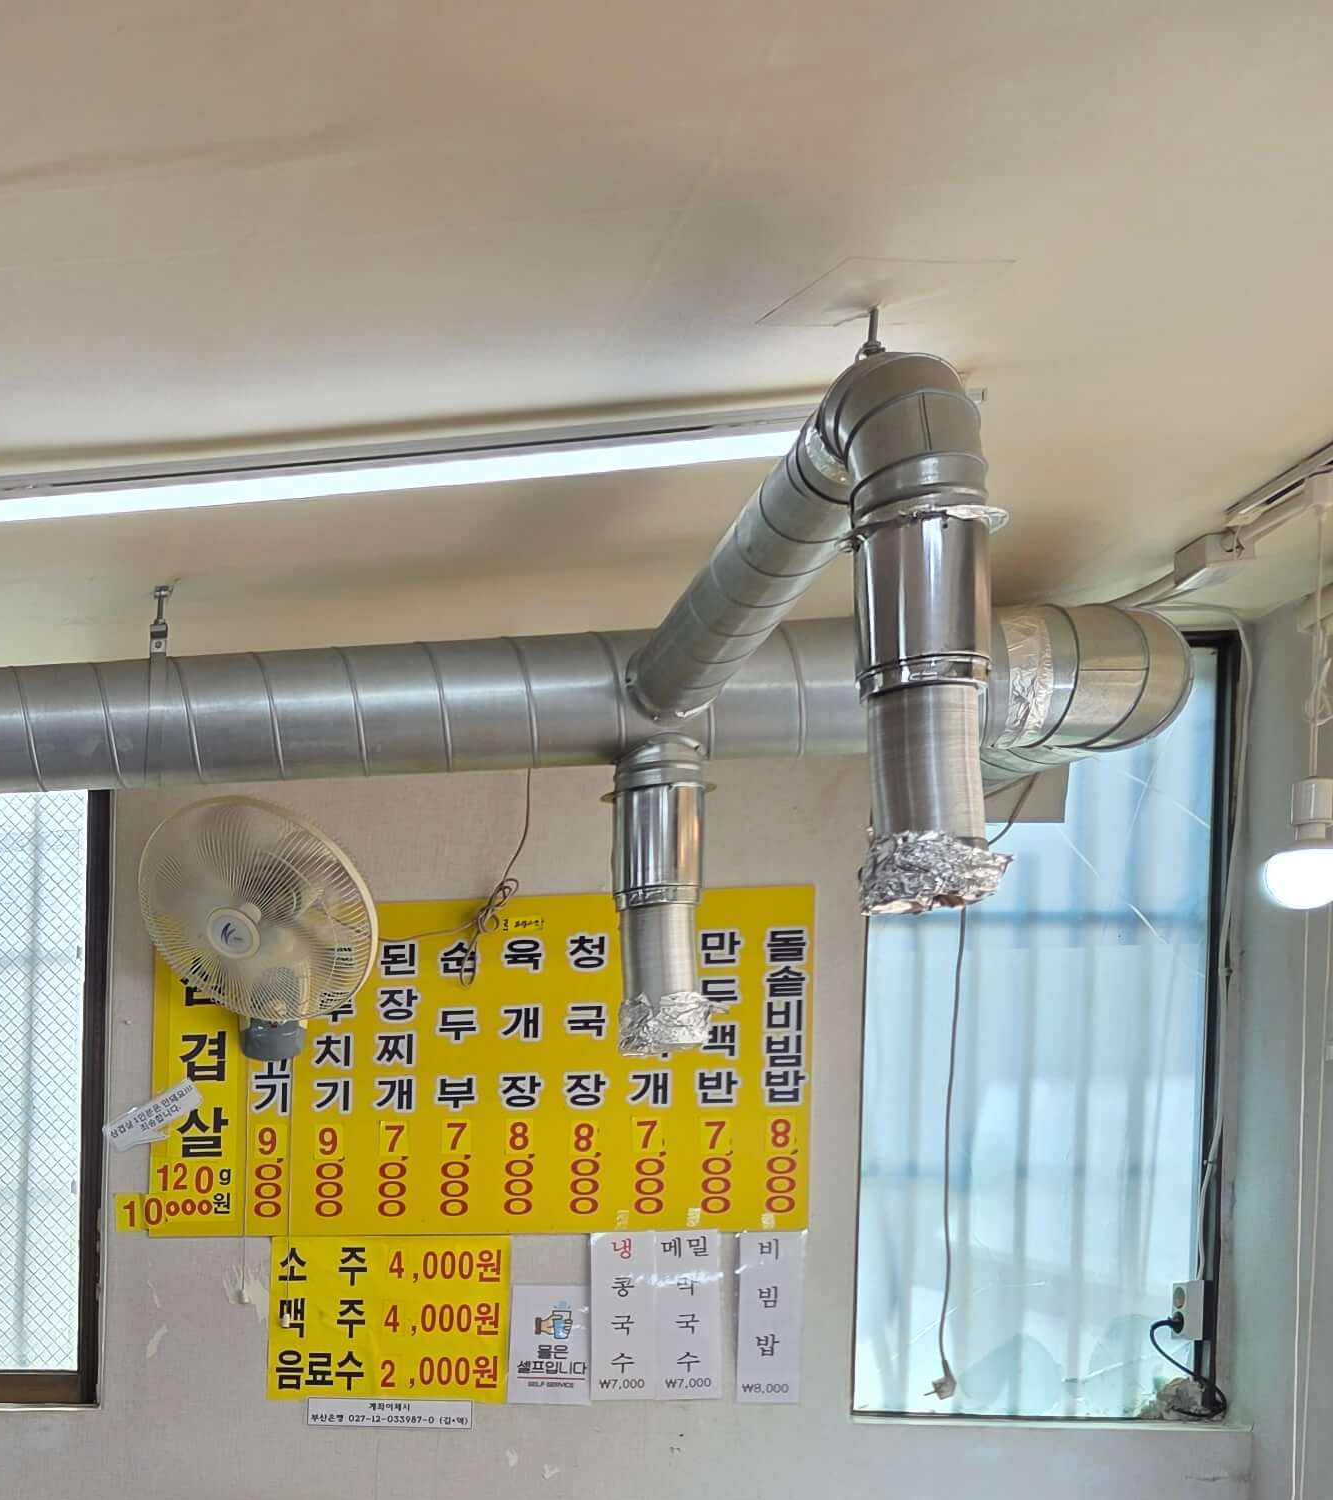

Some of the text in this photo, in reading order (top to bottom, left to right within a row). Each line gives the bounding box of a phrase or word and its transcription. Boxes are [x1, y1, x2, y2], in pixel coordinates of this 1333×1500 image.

[377, 942, 418, 1110] 된장찌개
[438, 940, 476, 1109] 순두부
[502, 938, 542, 1108] 육개장
[566, 935, 606, 1106] 청국장
[765, 929, 807, 1103] 돌솥비빔밥
[254, 1127, 283, 1217] 9,000
[315, 1128, 345, 1217] 9,000
[378, 1125, 410, 1216] 7,000
[439, 1123, 472, 1216] 7,000
[503, 1122, 536, 1215] 8,000
[569, 1123, 602, 1215] 8,000
[634, 1120, 667, 1215] 7,000
[700, 1121, 734, 1214] 7,000
[765, 1118, 799, 1214] 8,000
[275, 1350, 364, 1391] 음료수
[517, 1361, 587, 1375] 셀프입니다
[537, 1345, 569, 1359] 물은
[310, 1413, 344, 1423] 부산은행
